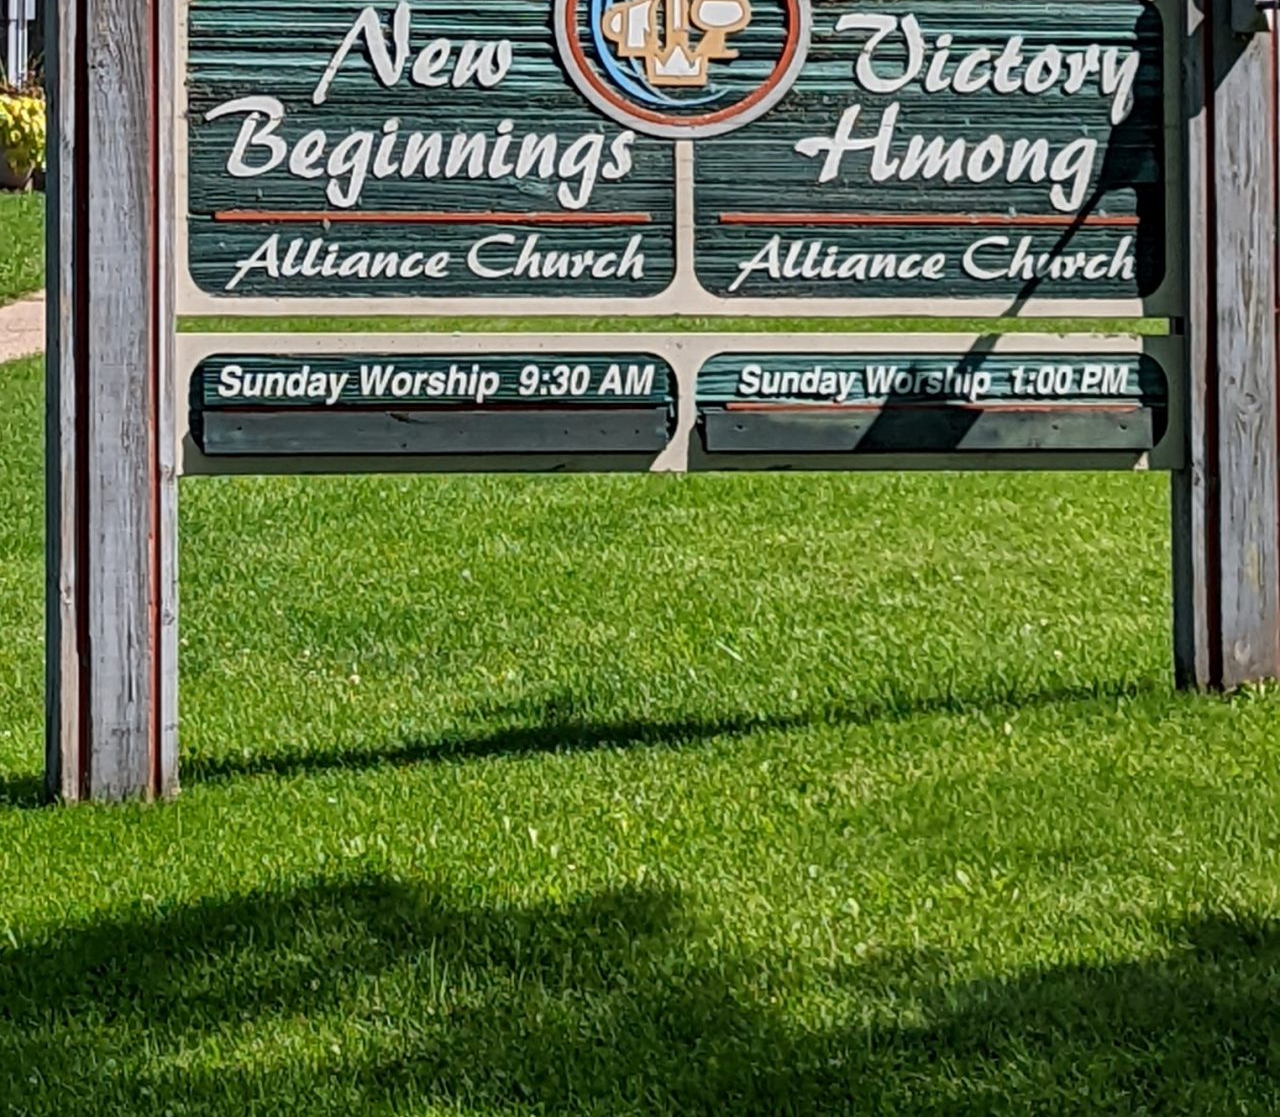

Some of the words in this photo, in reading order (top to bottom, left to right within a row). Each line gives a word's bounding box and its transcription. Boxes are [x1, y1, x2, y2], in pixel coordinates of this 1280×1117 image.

[312, 0, 513, 105] New
[835, 13, 1141, 125] Victory
[204, 96, 636, 210] Beginnings
[793, 102, 1098, 212] Hmong
[224, 233, 452, 290] Alliance
[466, 233, 645, 281] Church
[728, 235, 946, 292] Alliance
[961, 236, 1136, 281] Church
[218, 364, 349, 405] Sunday
[359, 365, 500, 403] Worship
[518, 365, 591, 397] 9:30
[597, 364, 655, 396] AM
[738, 364, 864, 403] Sunday
[866, 365, 992, 402] Worship
[1011, 365, 1073, 396] 1:00
[1080, 365, 1130, 396] PM
